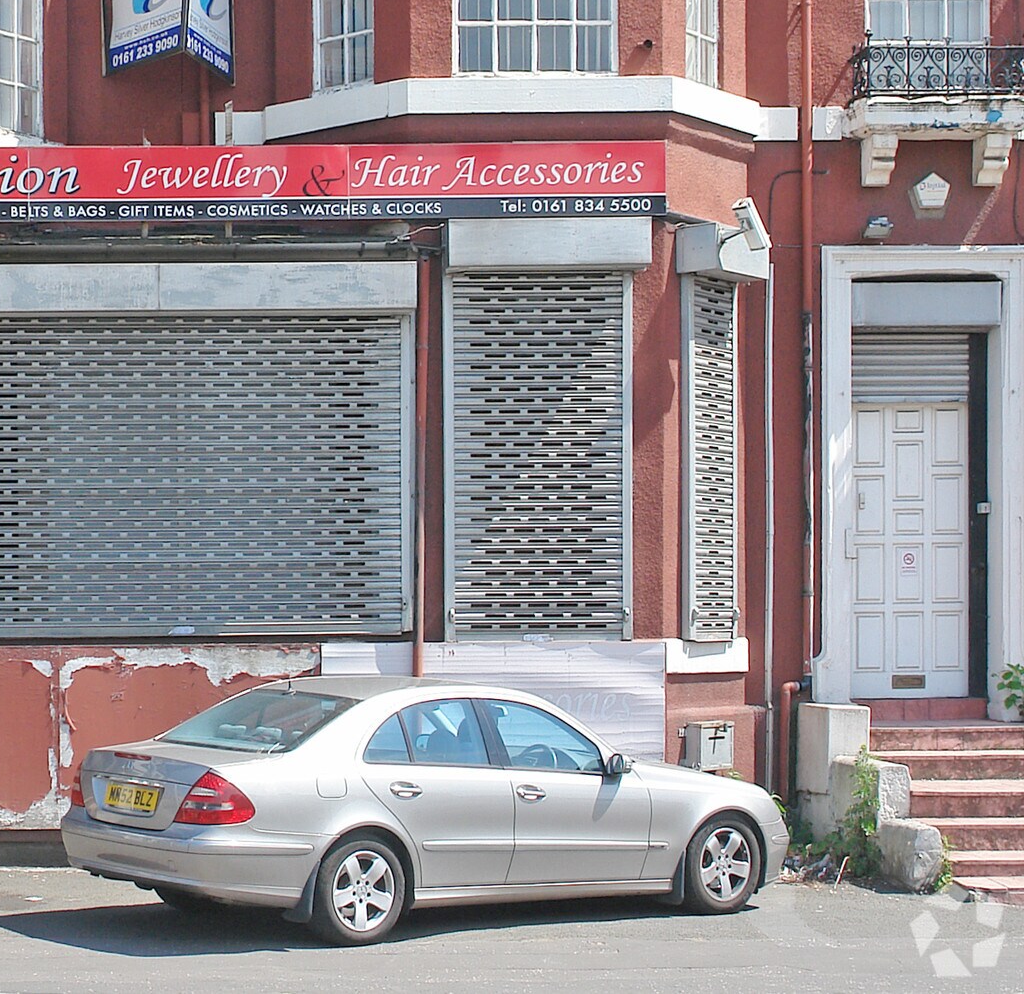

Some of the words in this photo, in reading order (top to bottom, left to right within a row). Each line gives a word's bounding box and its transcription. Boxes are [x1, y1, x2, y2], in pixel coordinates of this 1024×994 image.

[112, 49, 134, 67] 0161
[136, 43, 153, 60] 233
[155, 34, 179, 53] 9090
[116, 153, 287, 198] Jewellery
[302, 164, 345, 197] &
[351, 155, 440, 188] Hair
[441, 152, 645, 191] Accessories
[10, 205, 49, 217] BELTS
[52, 205, 64, 217] &
[68, 205, 107, 217] BAGS
[118, 205, 149, 217] GIFT
[153, 205, 195, 217] ITEMS
[207, 205, 288, 216] COSMETICS
[299, 204, 367, 216] WATCHES
[371, 203, 382, 215] &
[387, 202, 442, 214] CLOCKS
[500, 199, 527, 213] Tel:
[531, 199, 567, 213] 0161
[574, 199, 606, 212] 834
[609, 198, 652, 212] 5500
